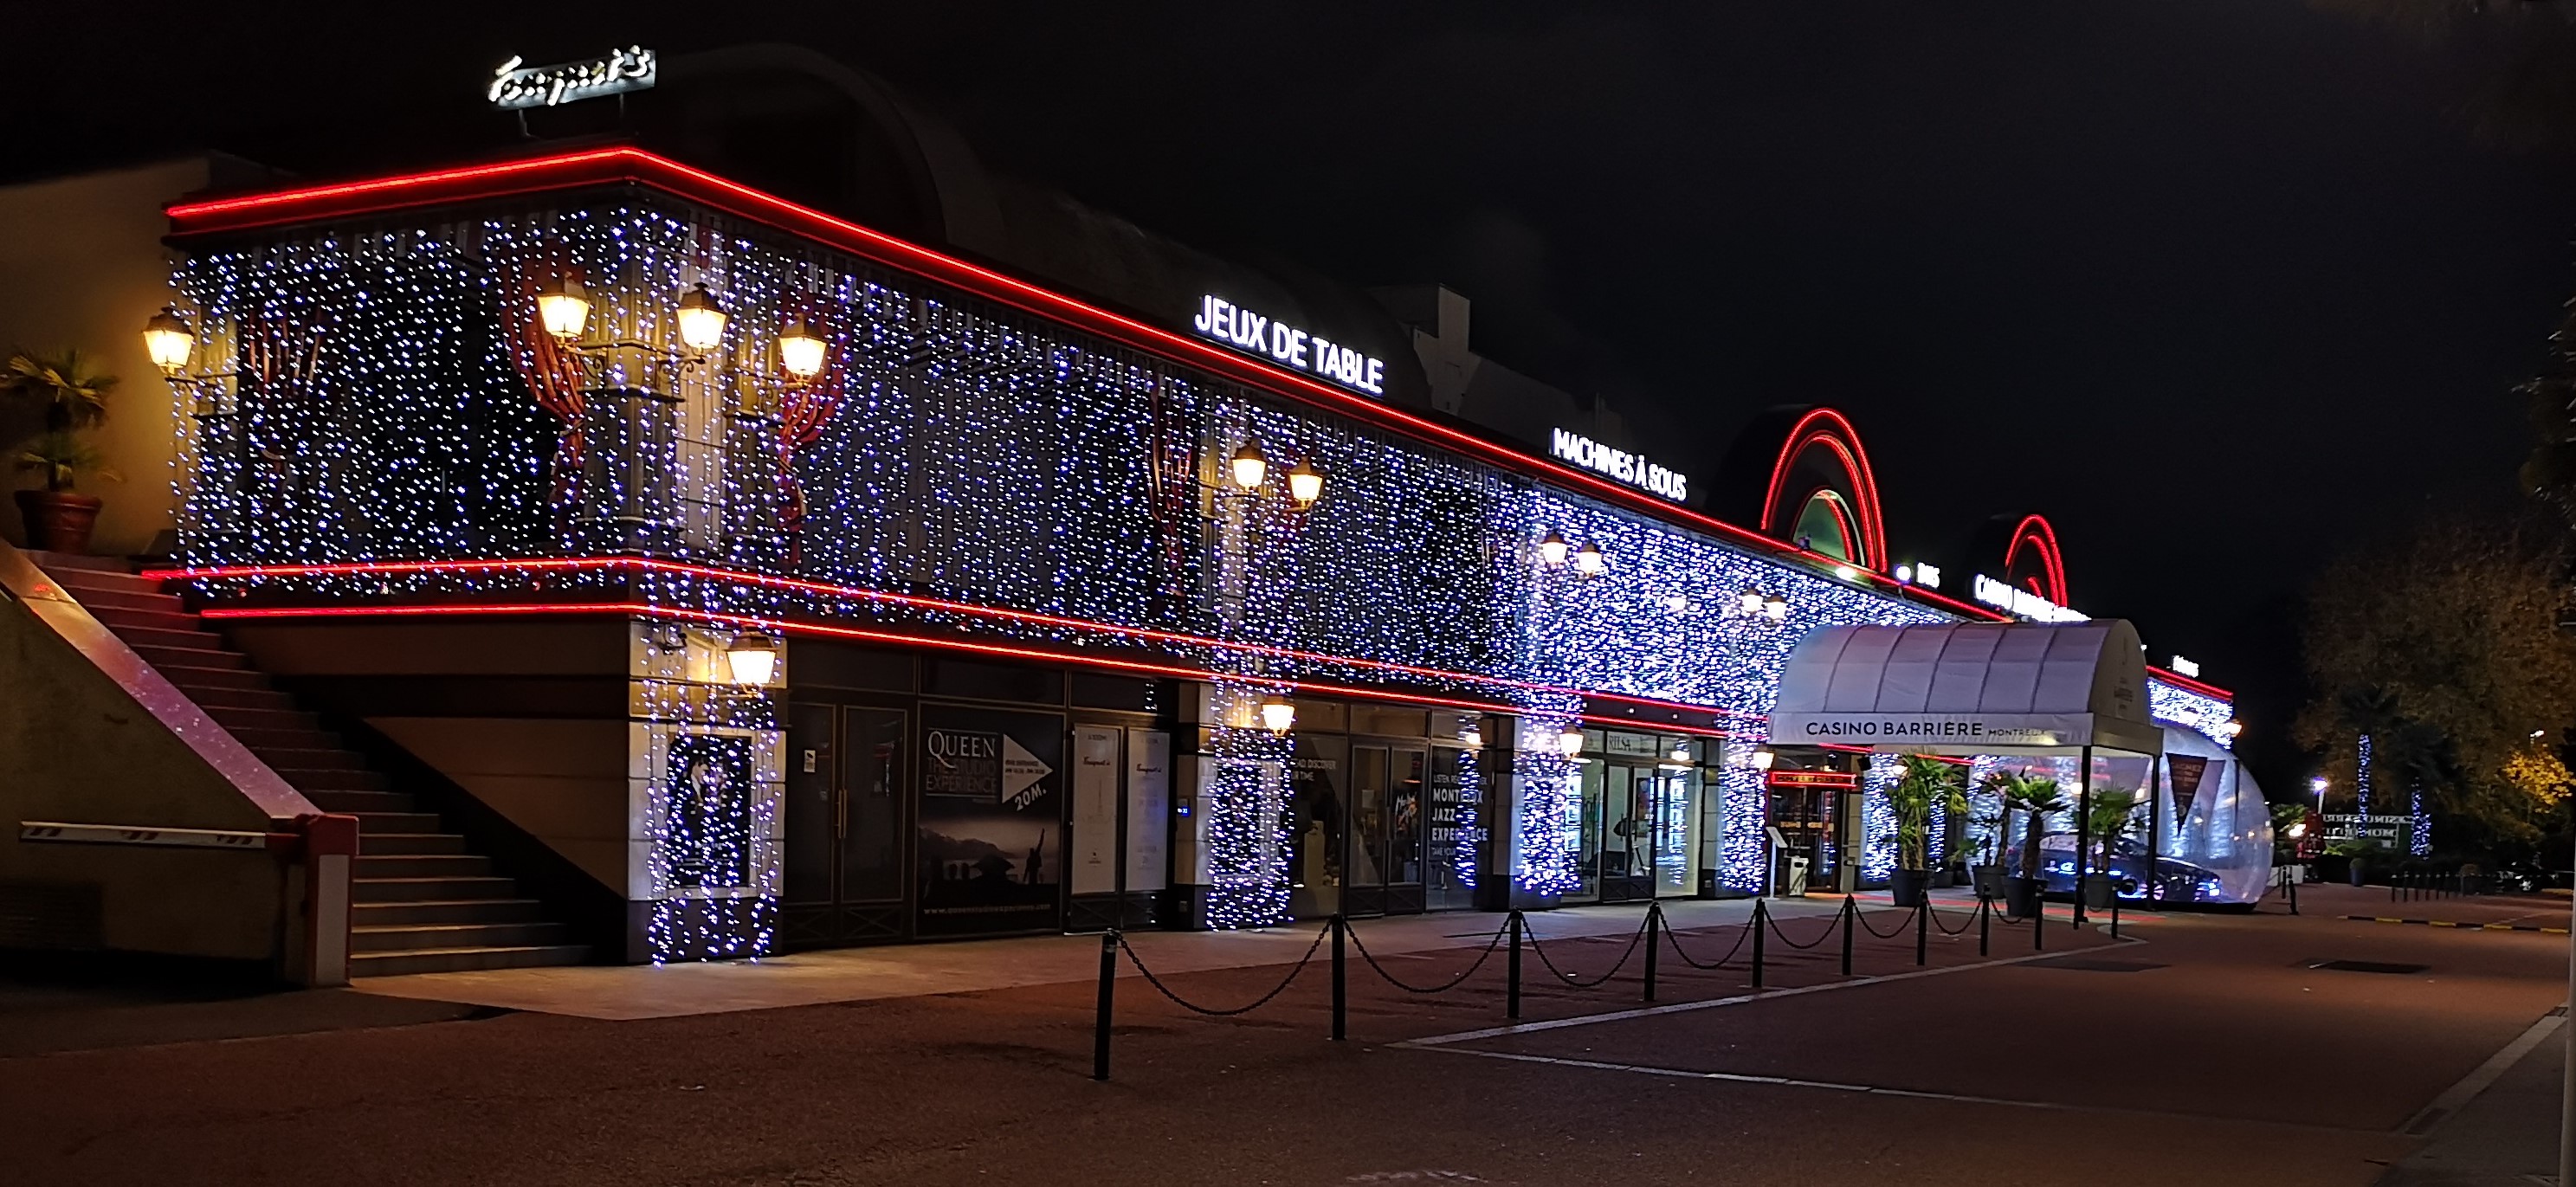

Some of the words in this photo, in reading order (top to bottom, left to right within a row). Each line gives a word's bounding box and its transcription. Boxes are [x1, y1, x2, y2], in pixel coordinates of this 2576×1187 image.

[1194, 294, 1268, 352] JEUX
[1271, 321, 1308, 368] DE
[1312, 336, 1384, 394] TABLE
[1553, 427, 1635, 482] MACHINES
[1648, 463, 1687, 502] SOUS
[1805, 721, 1877, 736] CASINO
[927, 730, 996, 769] QUEEN
[1432, 788, 1483, 806] MONTUX
[1431, 807, 1456, 823] JAZZ
[1431, 827, 1488, 842] EXPERENCE
